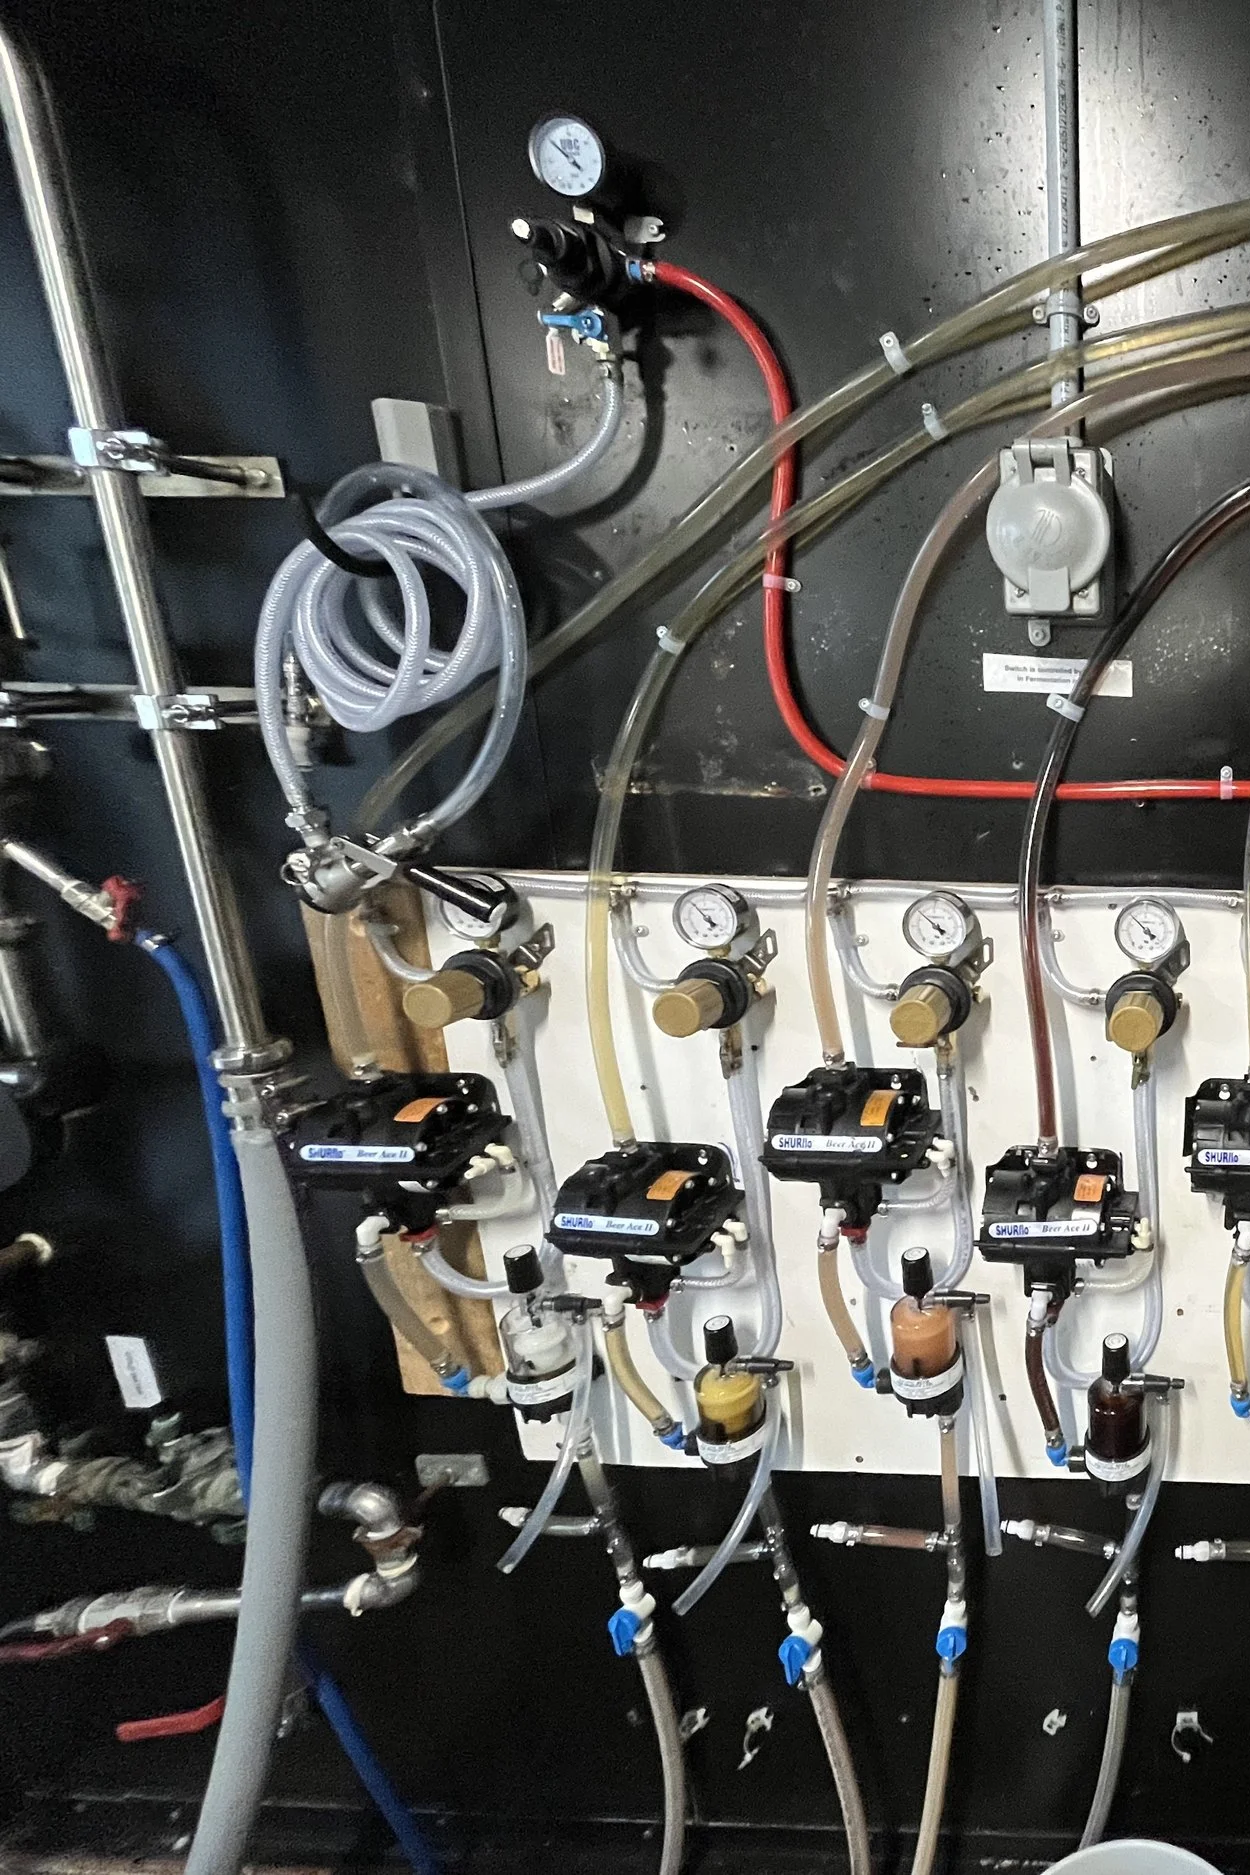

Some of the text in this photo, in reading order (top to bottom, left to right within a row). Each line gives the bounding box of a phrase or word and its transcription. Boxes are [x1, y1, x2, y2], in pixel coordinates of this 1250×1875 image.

[1004, 664, 1028, 672] Switch
[826, 1139, 846, 1148] Beer
[848, 1140, 866, 1148] Ace
[606, 1220, 625, 1229] Beer
[627, 1222, 642, 1231] Ace
[1042, 1225, 1061, 1233] Beer
[1064, 1224, 1080, 1232] Ace
[1082, 1224, 1090, 1232] II
